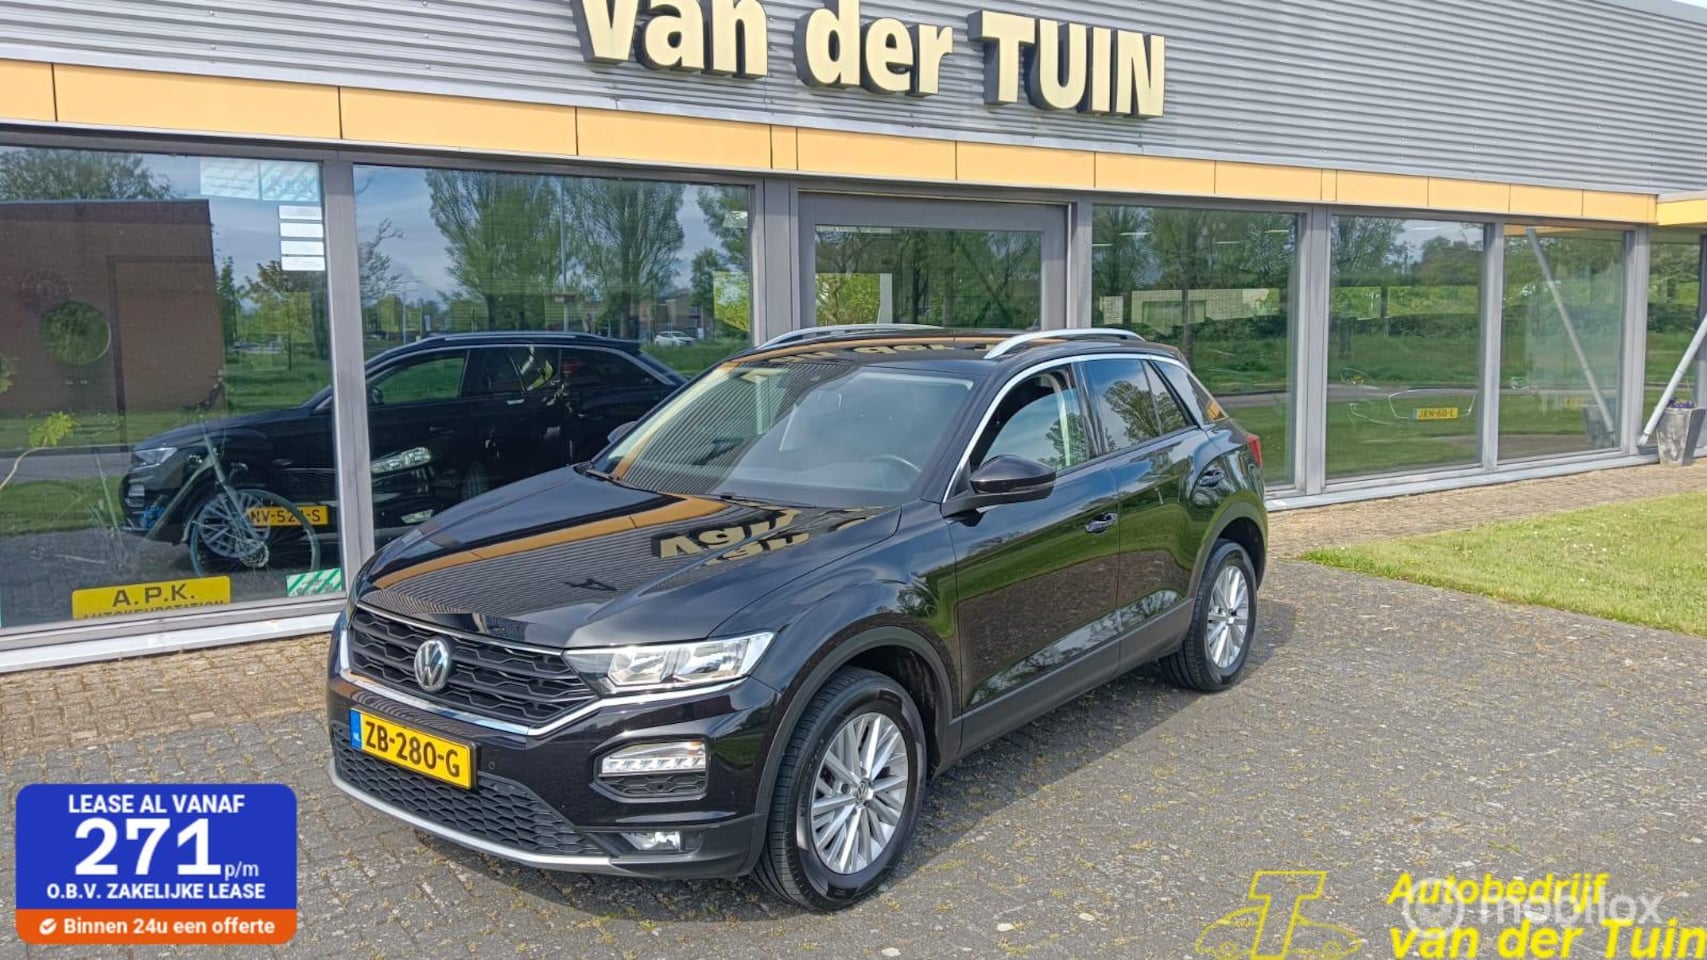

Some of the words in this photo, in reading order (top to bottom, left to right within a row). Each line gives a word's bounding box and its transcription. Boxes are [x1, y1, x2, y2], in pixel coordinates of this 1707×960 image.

[578, 0, 768, 77] van
[804, 0, 953, 95] der
[980, 9, 1166, 117] TUIN
[112, 583, 195, 607] A.P.K.
[365, 720, 460, 778] ZB-280-G
